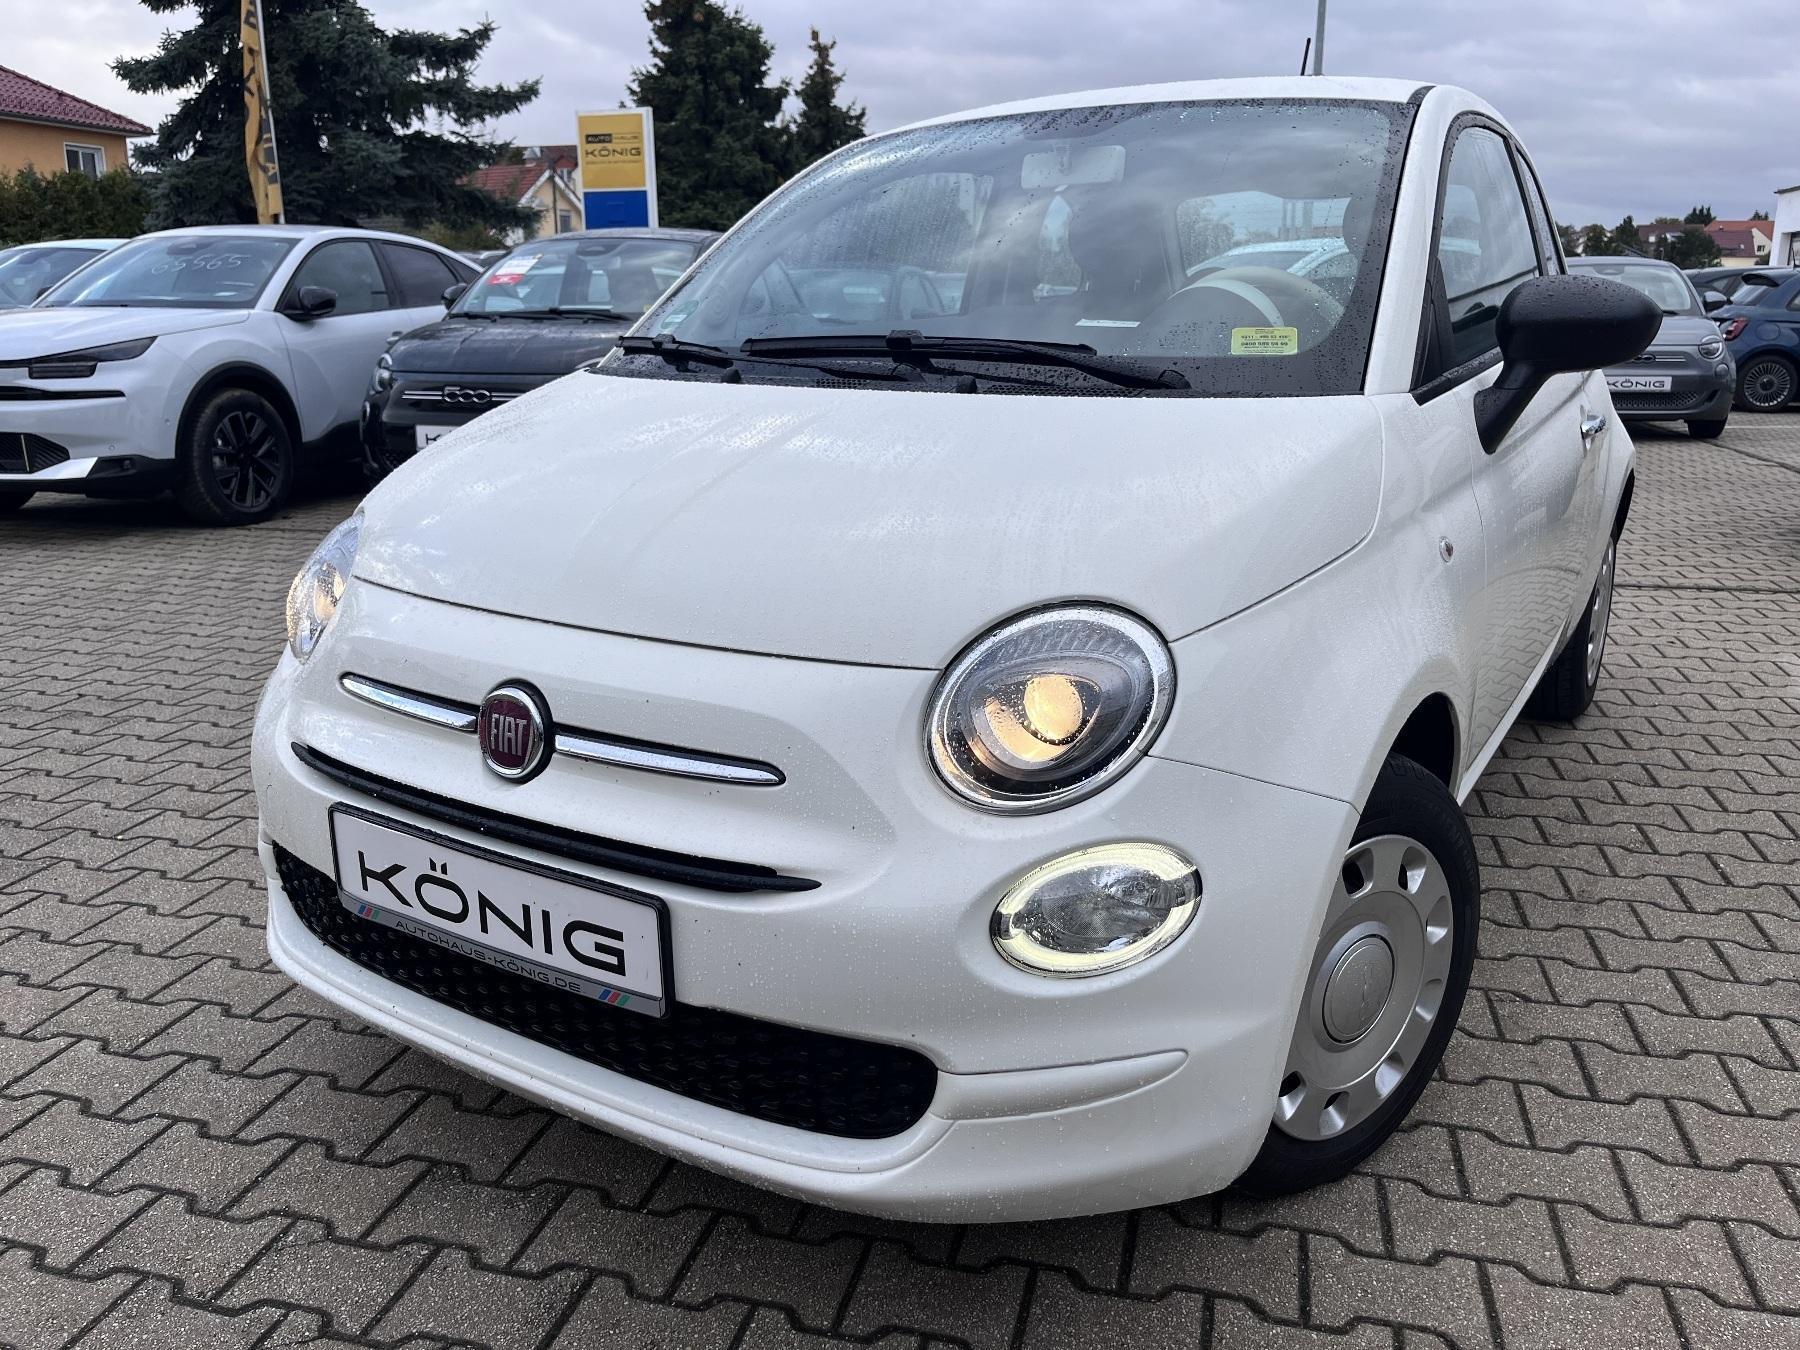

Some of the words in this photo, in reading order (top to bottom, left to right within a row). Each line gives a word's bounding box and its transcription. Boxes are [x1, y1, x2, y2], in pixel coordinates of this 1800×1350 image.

[585, 146, 641, 158] KÖNIG
[444, 386, 491, 403] 500
[490, 713, 528, 756] FIAT
[357, 849, 627, 977] KÖNIG
[395, 920, 582, 993] AUTOHAUS-KÖNIG.DE
